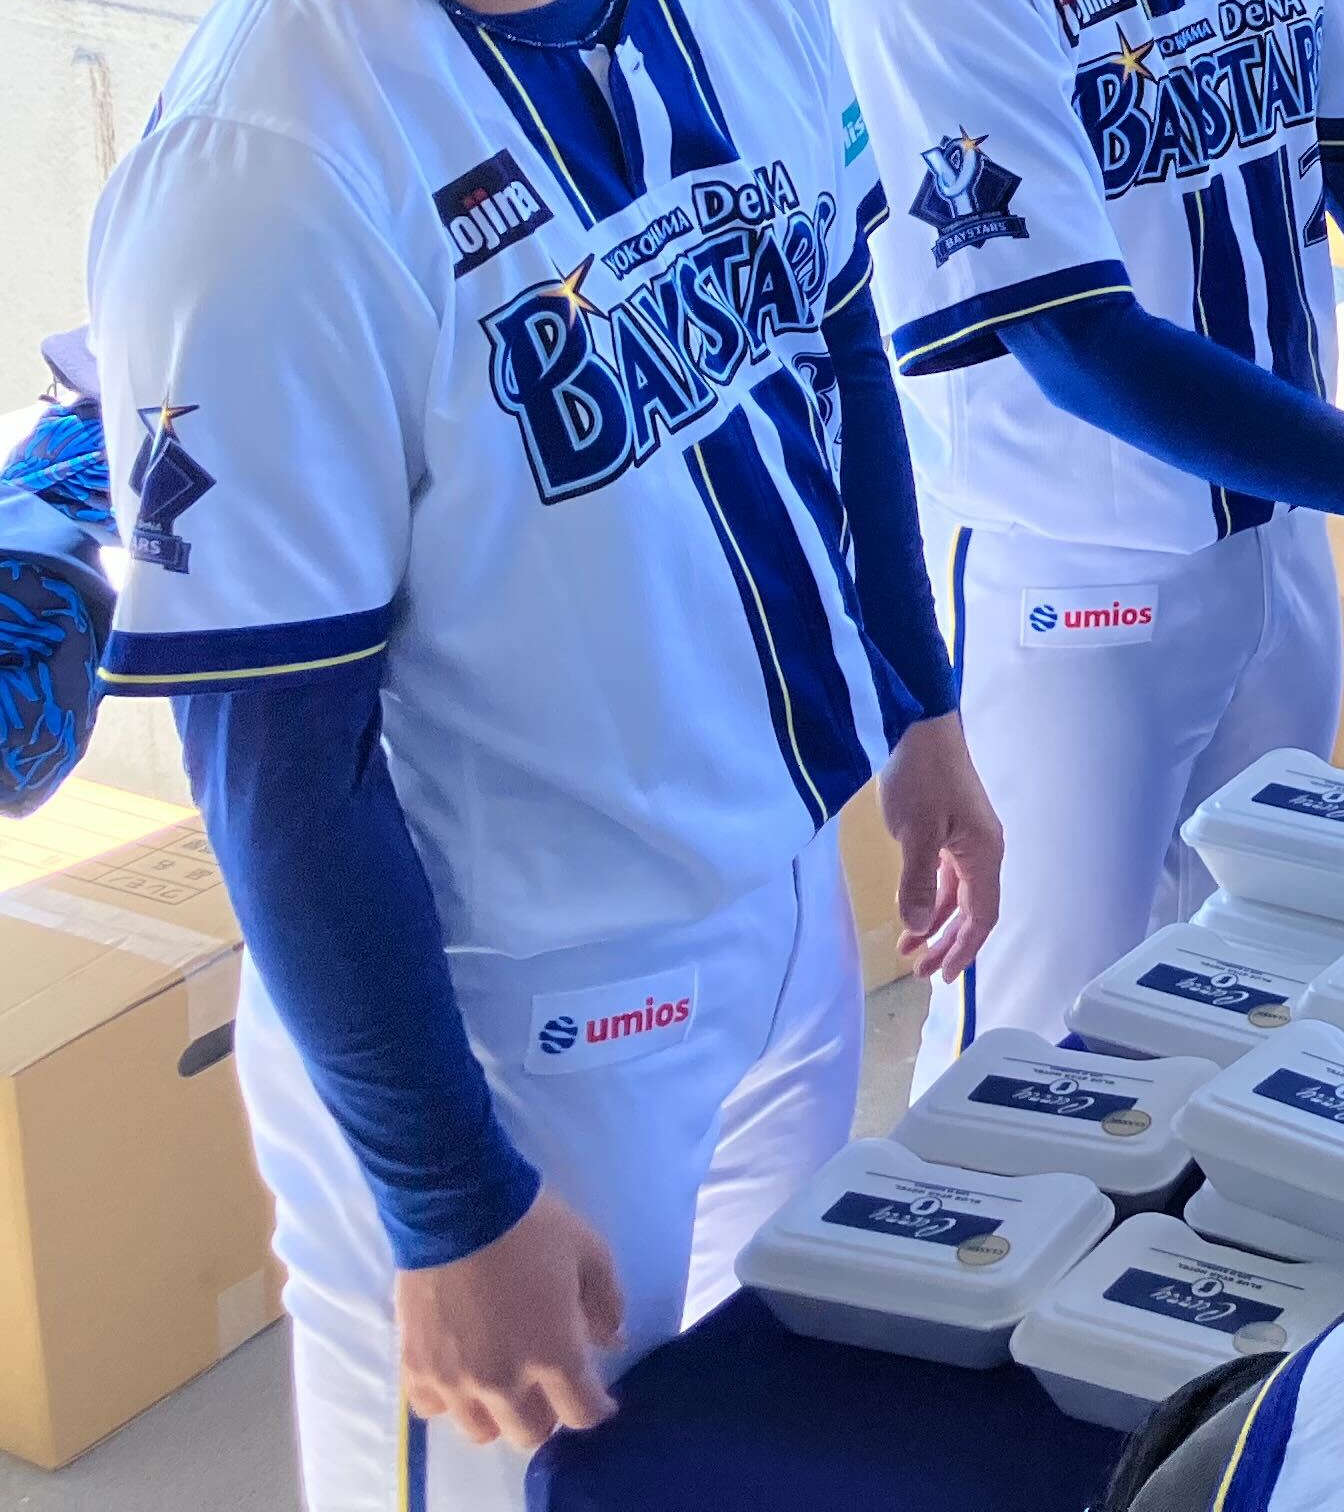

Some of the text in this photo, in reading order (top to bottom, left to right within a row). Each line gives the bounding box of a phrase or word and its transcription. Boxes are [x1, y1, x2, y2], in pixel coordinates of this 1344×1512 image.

[692, 160, 802, 234] DeNA
[944, 222, 1008, 250] BAYSTARS
[1064, 601, 1153, 629] umios
[1175, 978, 1250, 1006] Curry
[586, 996, 691, 1045] umios
[1010, 1086, 1096, 1116] Curry
[868, 1205, 957, 1239] Curry
[1149, 1284, 1237, 1323] Curry
